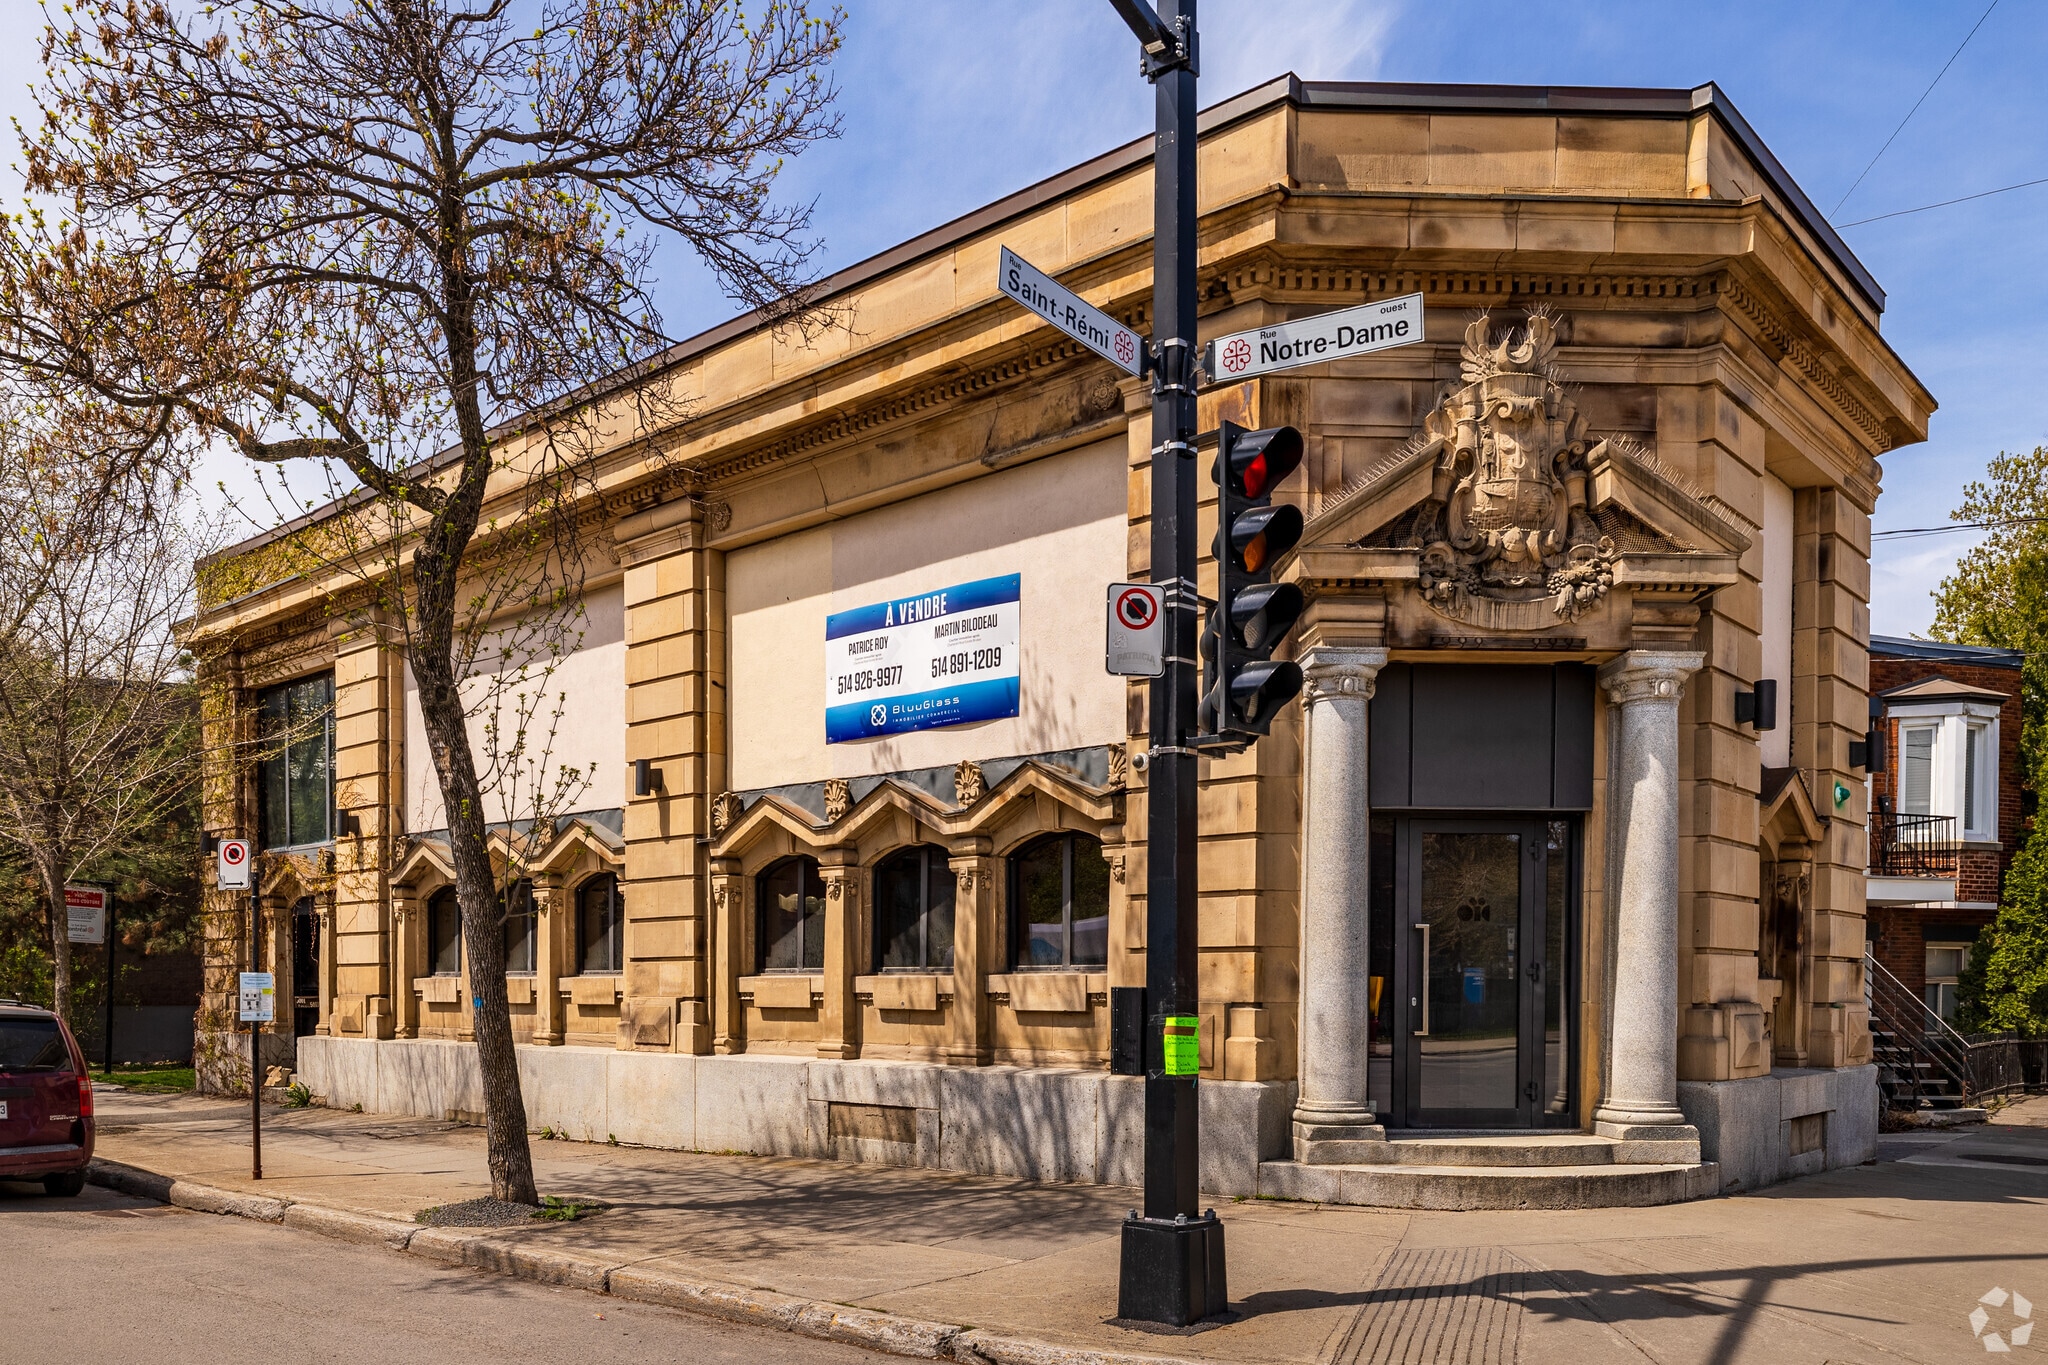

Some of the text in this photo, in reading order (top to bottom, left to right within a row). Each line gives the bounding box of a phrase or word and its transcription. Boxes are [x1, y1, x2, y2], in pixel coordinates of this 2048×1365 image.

[1009, 255, 1022, 271] Rue
[1007, 268, 1110, 350] Saint-Rémi
[1380, 301, 1408, 315] ouest
[1260, 330, 1277, 340] Rue
[1260, 318, 1410, 365] Notre-Dame
[885, 593, 947, 627] À VENDRE
[934, 620, 961, 640] MARTIN
[961, 613, 998, 633] BILODEAU
[848, 635, 889, 656] PATRICE ROY
[931, 646, 1002, 679] 514 891-1209
[837, 664, 903, 695] 514 926-9977
[892, 696, 960, 714] BluuGlass
[892, 714, 924, 723] IMMOBILIER
[926, 708, 960, 718] COMMERCIAL
